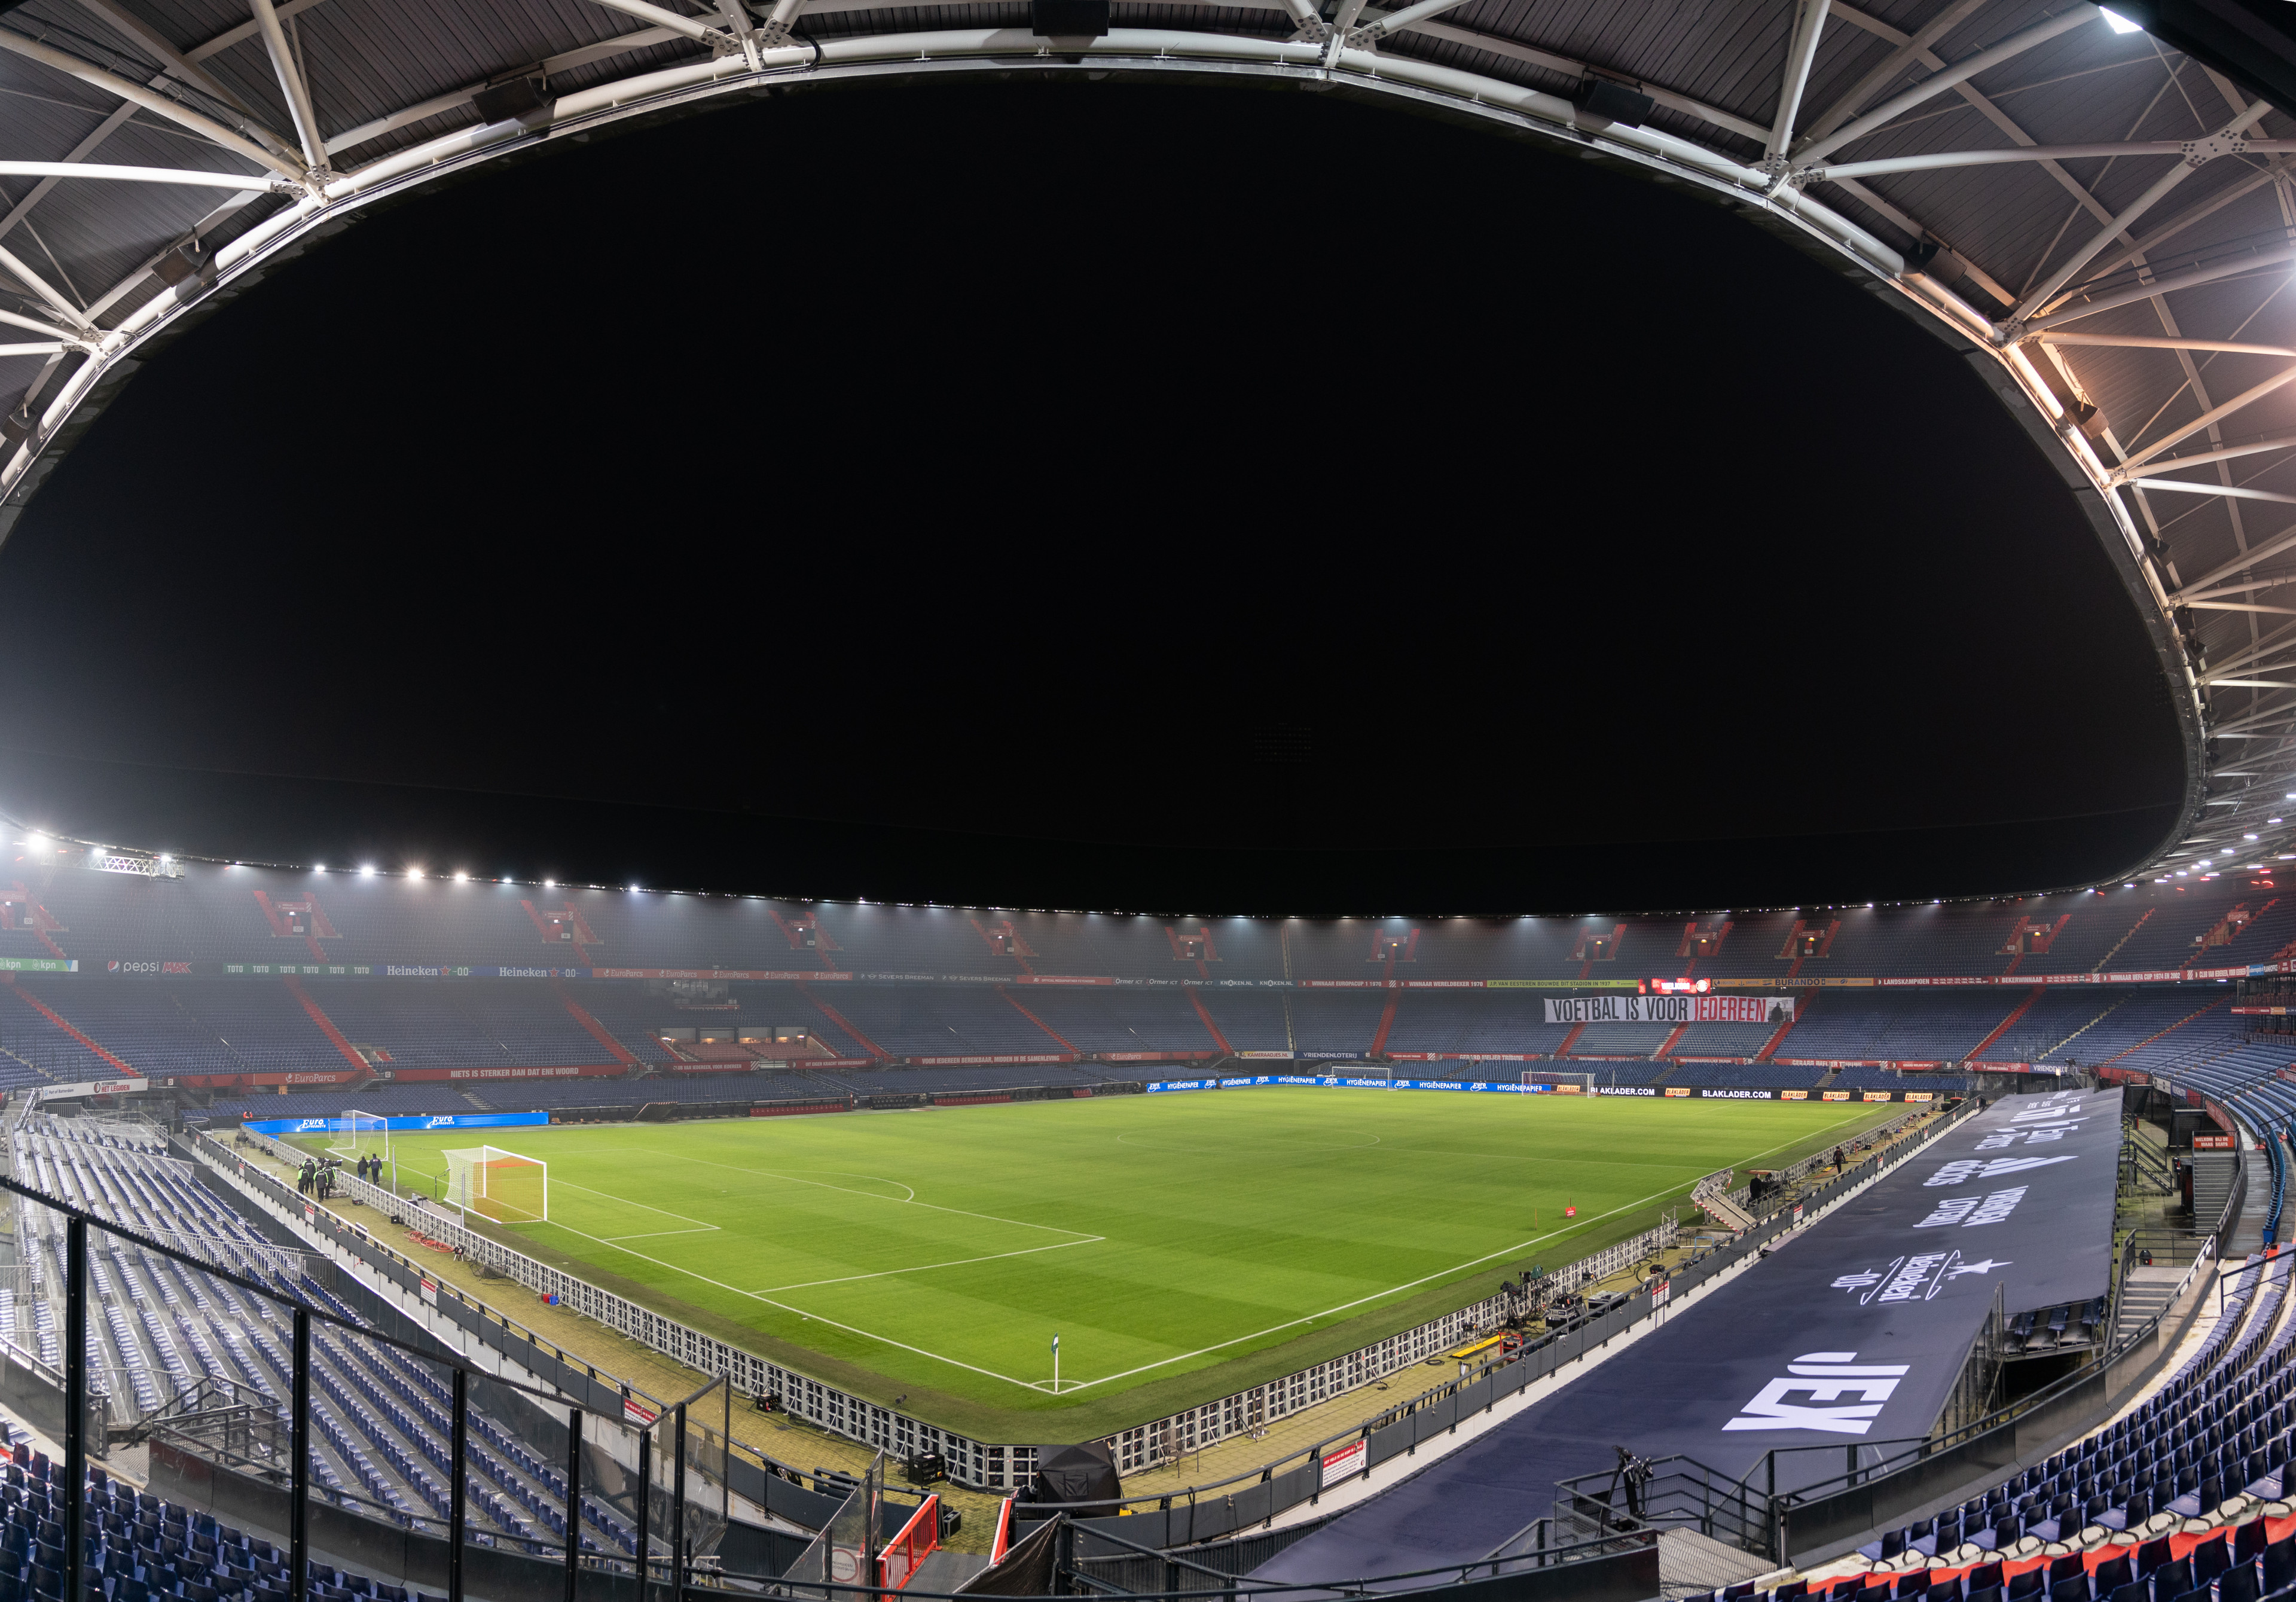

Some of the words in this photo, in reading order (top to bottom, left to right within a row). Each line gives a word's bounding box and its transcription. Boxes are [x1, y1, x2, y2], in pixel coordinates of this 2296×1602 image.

[6, 960, 21, 970] kpn
[41, 960, 56, 970] kpn
[124, 962, 159, 973] pepsi
[162, 962, 192, 974] MAX
[387, 966, 438, 975] Heineken
[499, 968, 547, 977] Heineken
[1552, 997, 1620, 1021] VOETBAL
[1626, 997, 1639, 1021] IS
[1647, 997, 1688, 1021] VOOR
[1694, 997, 1767, 1021] IEDEREEN
[295, 1072, 336, 1084] EuroParcs
[1223, 1078, 1251, 1087] HYGIËNEPAPIER
[1419, 1081, 1462, 1090] HYGIËNEPAPIER
[1702, 1090, 1771, 1098] BLAKLADER.COM
[1922, 1159, 1990, 1186] adidas
[1913, 1196, 1982, 1228] LOTERIJ
[1961, 1185, 2029, 1228] VRIENDEN
[1878, 1252, 1947, 1302] Heineken
[1721, 1352, 1910, 1435] JEX
